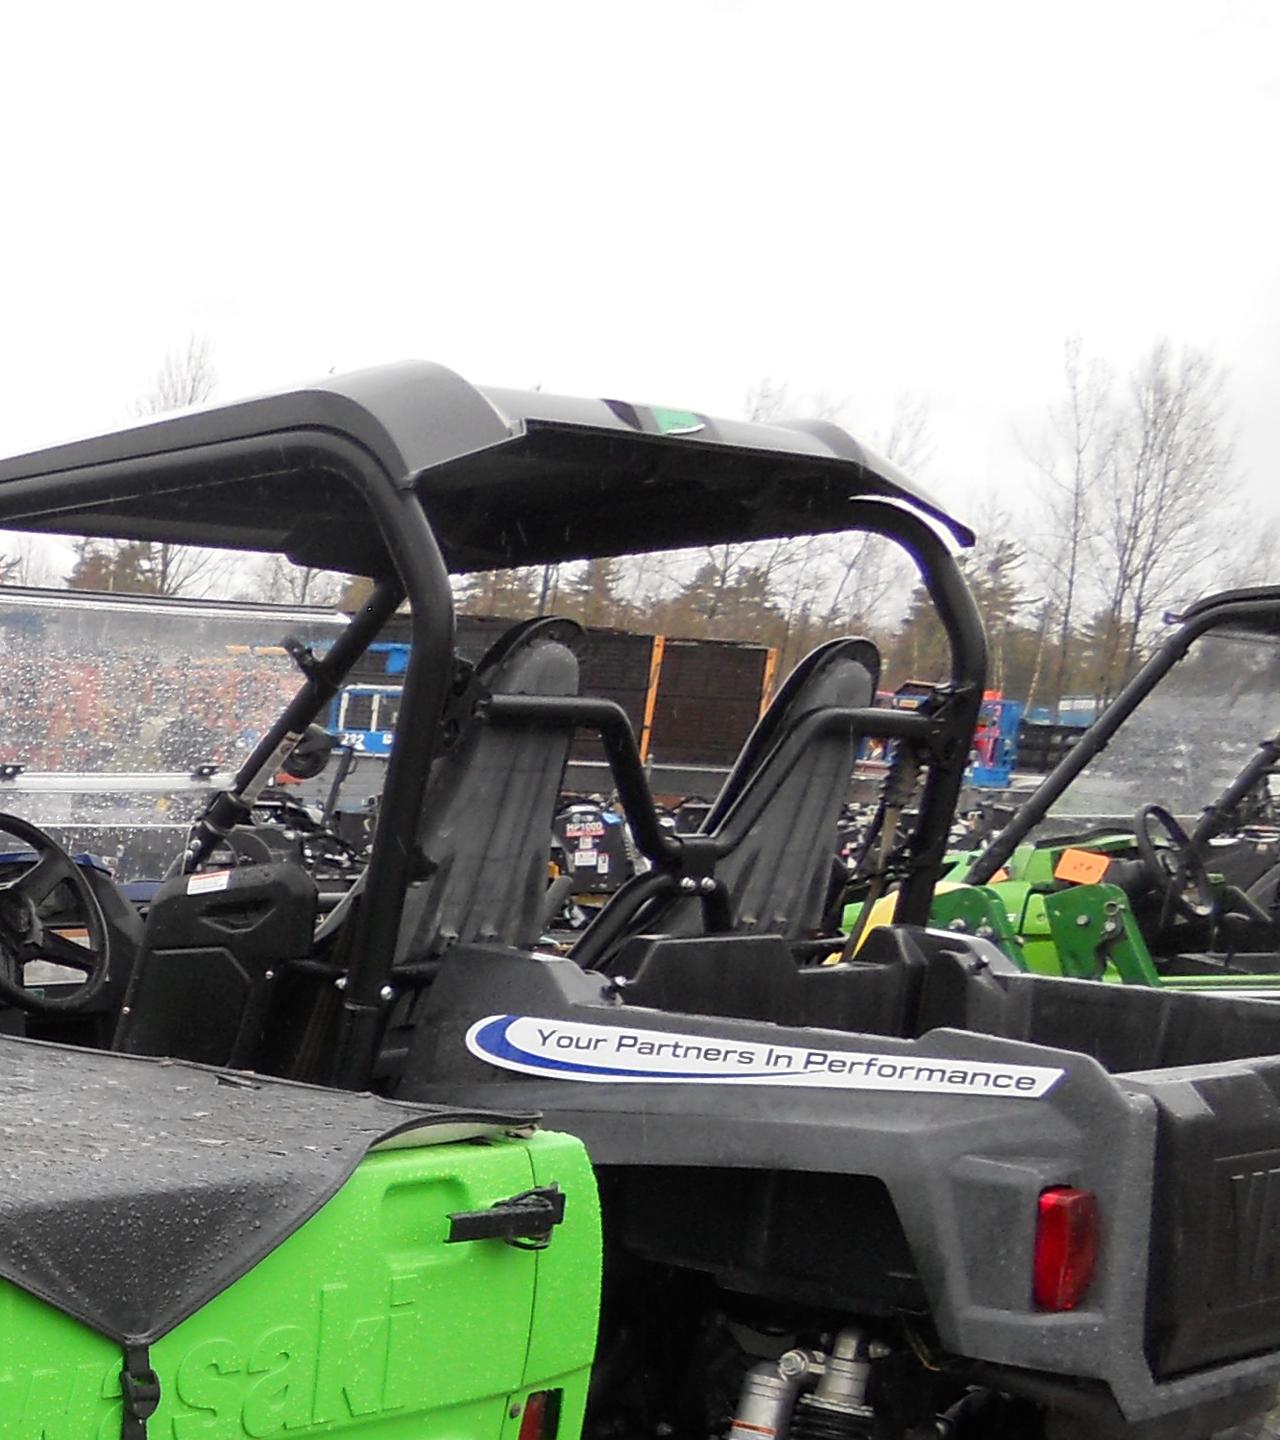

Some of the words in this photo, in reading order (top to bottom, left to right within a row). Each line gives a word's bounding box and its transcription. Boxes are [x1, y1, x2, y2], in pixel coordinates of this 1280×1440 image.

[537, 1028, 607, 1051] Your
[615, 1035, 755, 1064] Partners
[764, 1047, 793, 1069] In
[803, 1052, 1037, 1091] Performance
